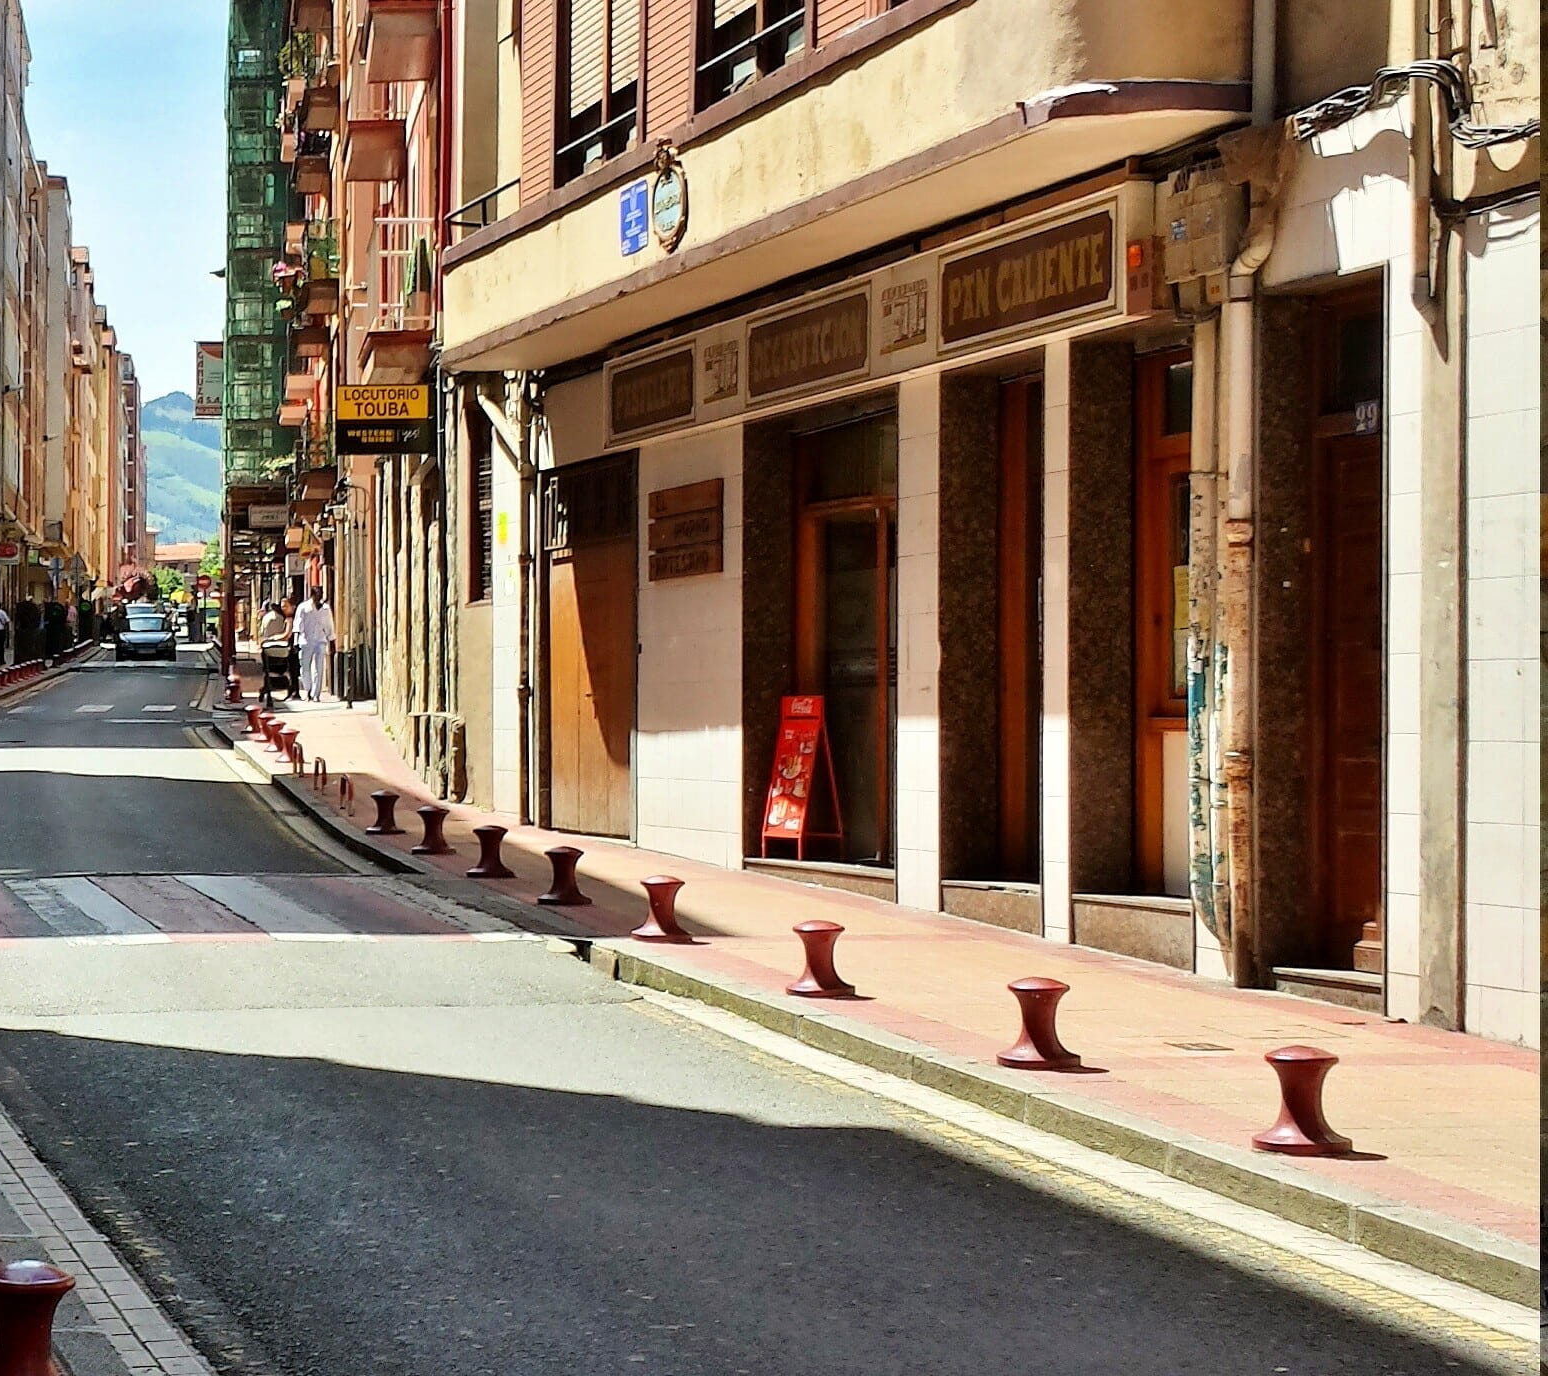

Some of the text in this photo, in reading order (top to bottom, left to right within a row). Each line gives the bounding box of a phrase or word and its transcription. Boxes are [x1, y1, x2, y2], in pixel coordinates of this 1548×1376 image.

[947, 231, 1105, 321] PAN CALIENTE
[343, 388, 419, 401] LOCUTORIO
[354, 402, 409, 417] TOUBA
[1355, 404, 1378, 432] 29
